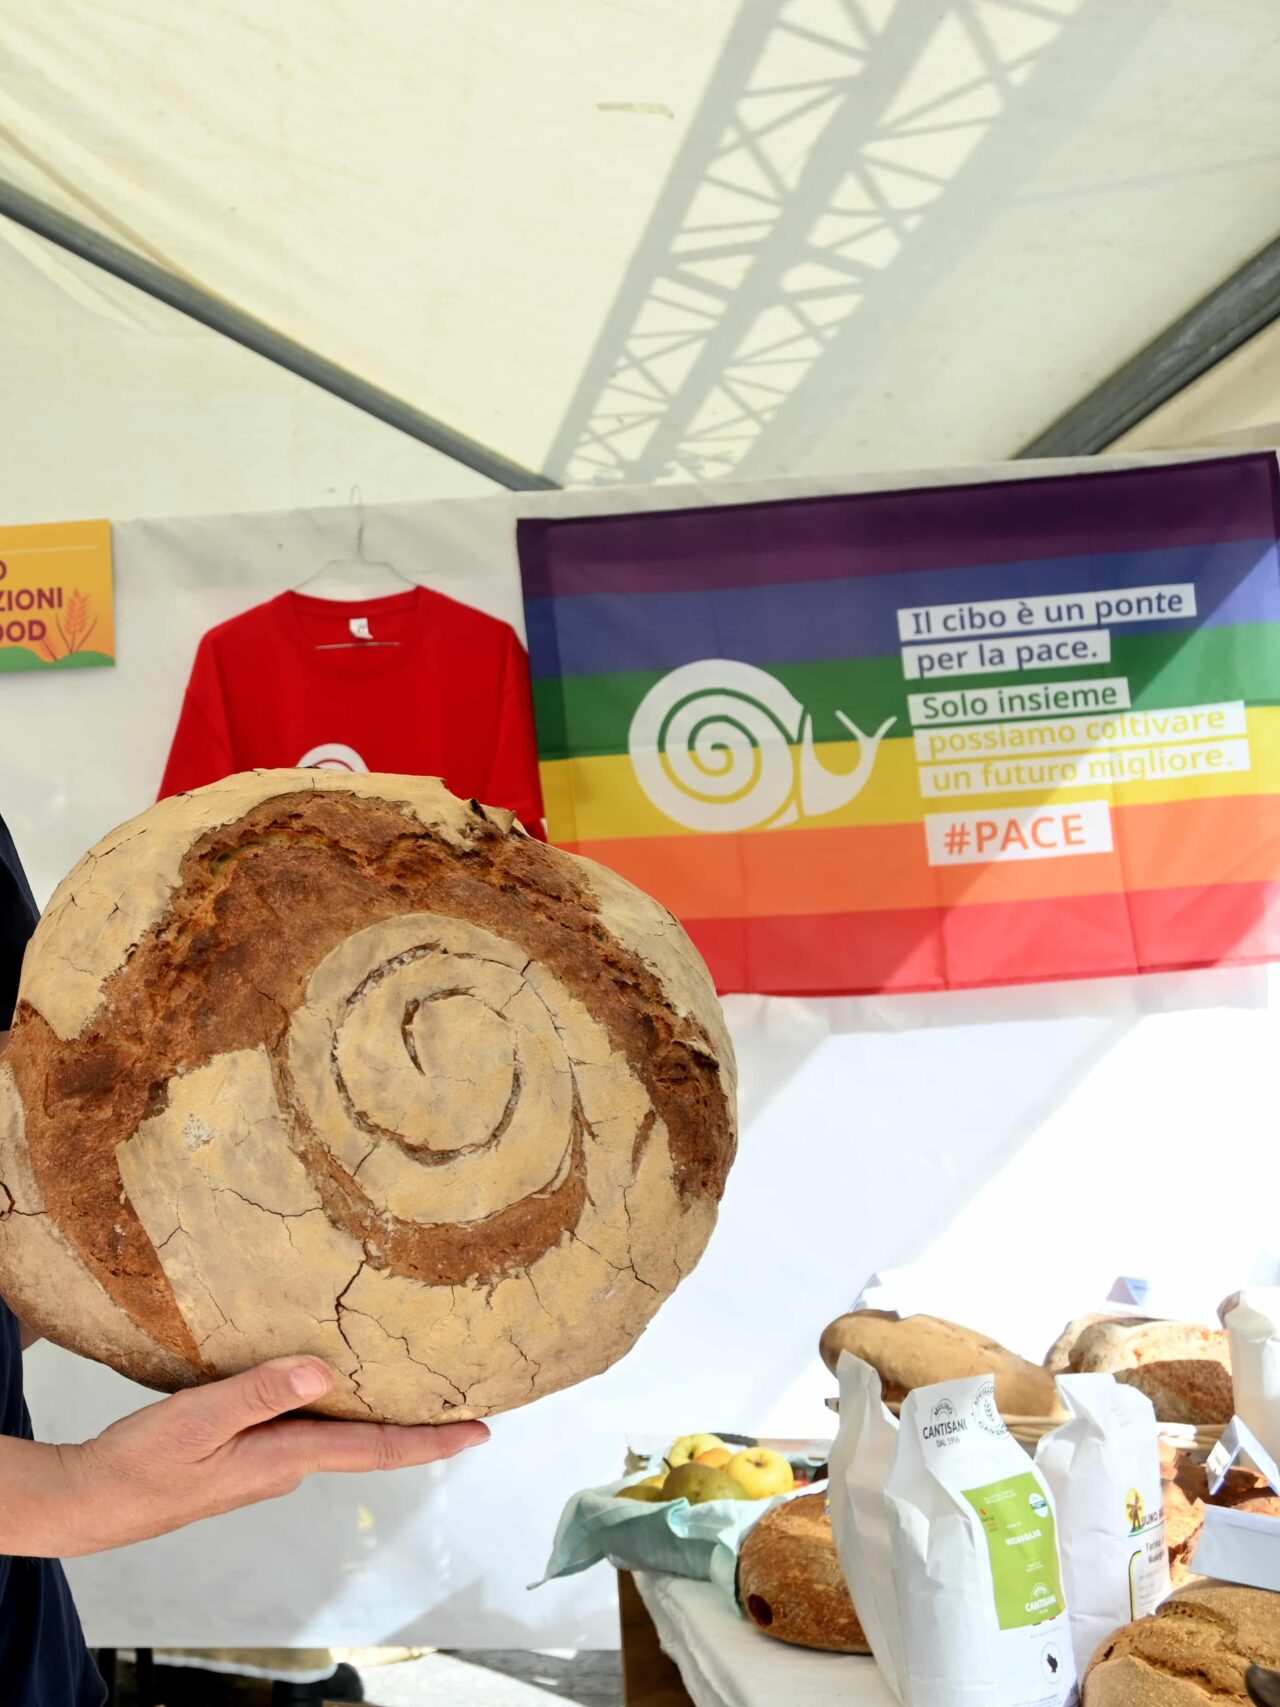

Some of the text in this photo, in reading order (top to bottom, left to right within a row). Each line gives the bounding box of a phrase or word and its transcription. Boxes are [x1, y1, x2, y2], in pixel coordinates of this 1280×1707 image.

[912, 591, 1183, 635] Il cibo è un ponte
[917, 639, 1099, 676] per la pace.
[923, 685, 1118, 720] Solo insieme
[929, 710, 1226, 758] possiamo coltivare
[933, 746, 1233, 791] un futuro migliore.
[943, 813, 1086, 855] #PACE
[922, 1418, 968, 1440] CANTISANI
